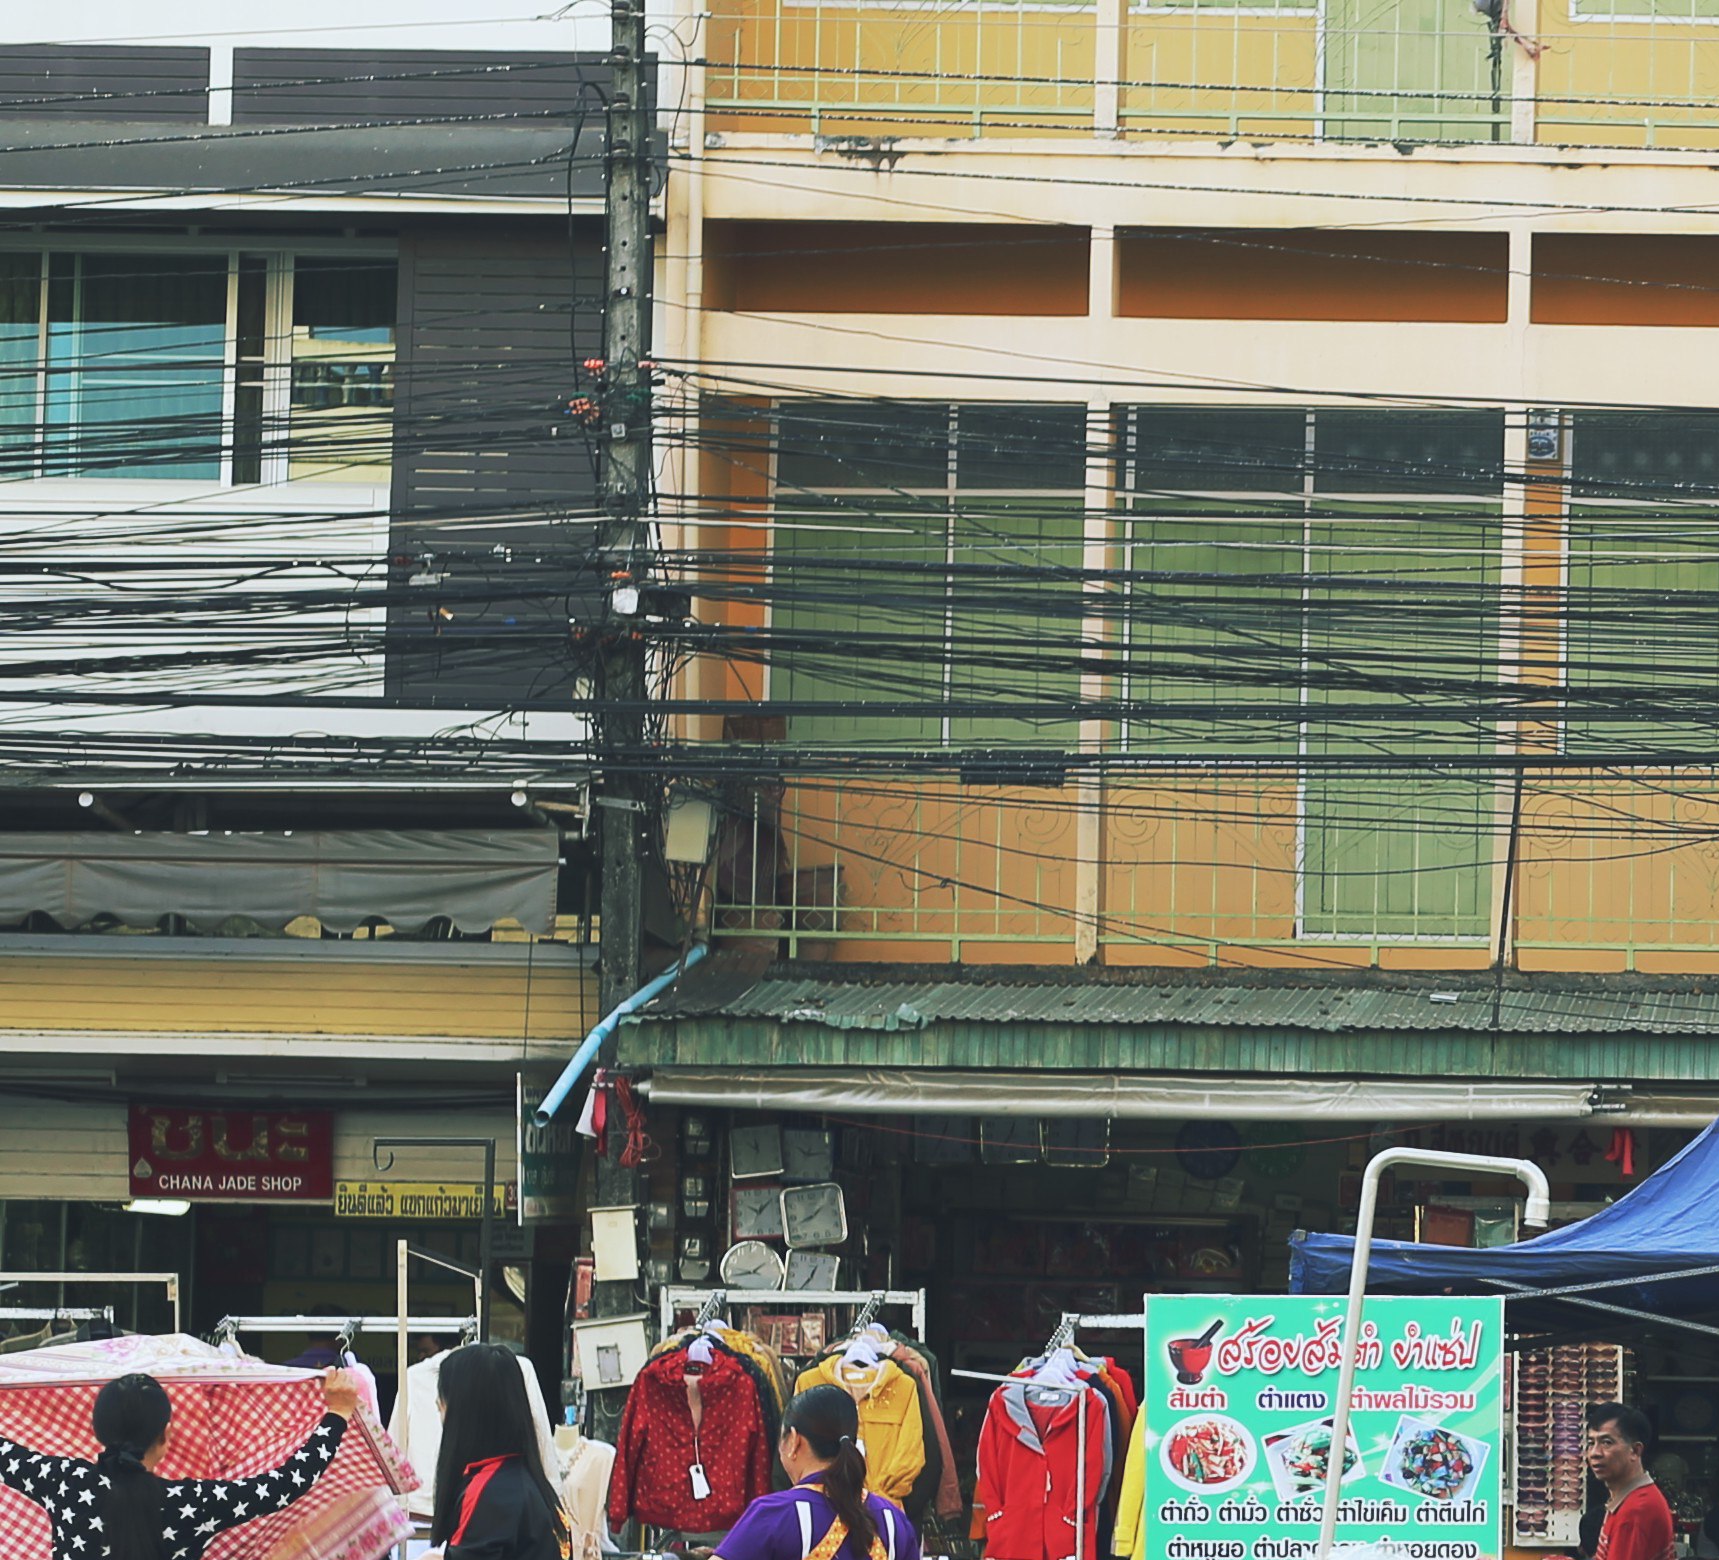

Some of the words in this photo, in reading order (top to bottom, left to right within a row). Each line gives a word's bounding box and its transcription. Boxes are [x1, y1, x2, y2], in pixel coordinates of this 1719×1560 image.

[158, 1174, 214, 1190] CHANA
[218, 1175, 257, 1191] JADE
[261, 1175, 302, 1191] SHOP
[1168, 1385, 1227, 1411] ส้มตำ
[1258, 1386, 1327, 1410] ตำแตง
[1349, 1384, 1476, 1411] ตำผลไม้รวม
[1160, 1497, 1210, 1524] ตำถั่ว
[1218, 1497, 1269, 1524] ตำมั่ว
[1415, 1499, 1487, 1525] ตำตีนไก่
